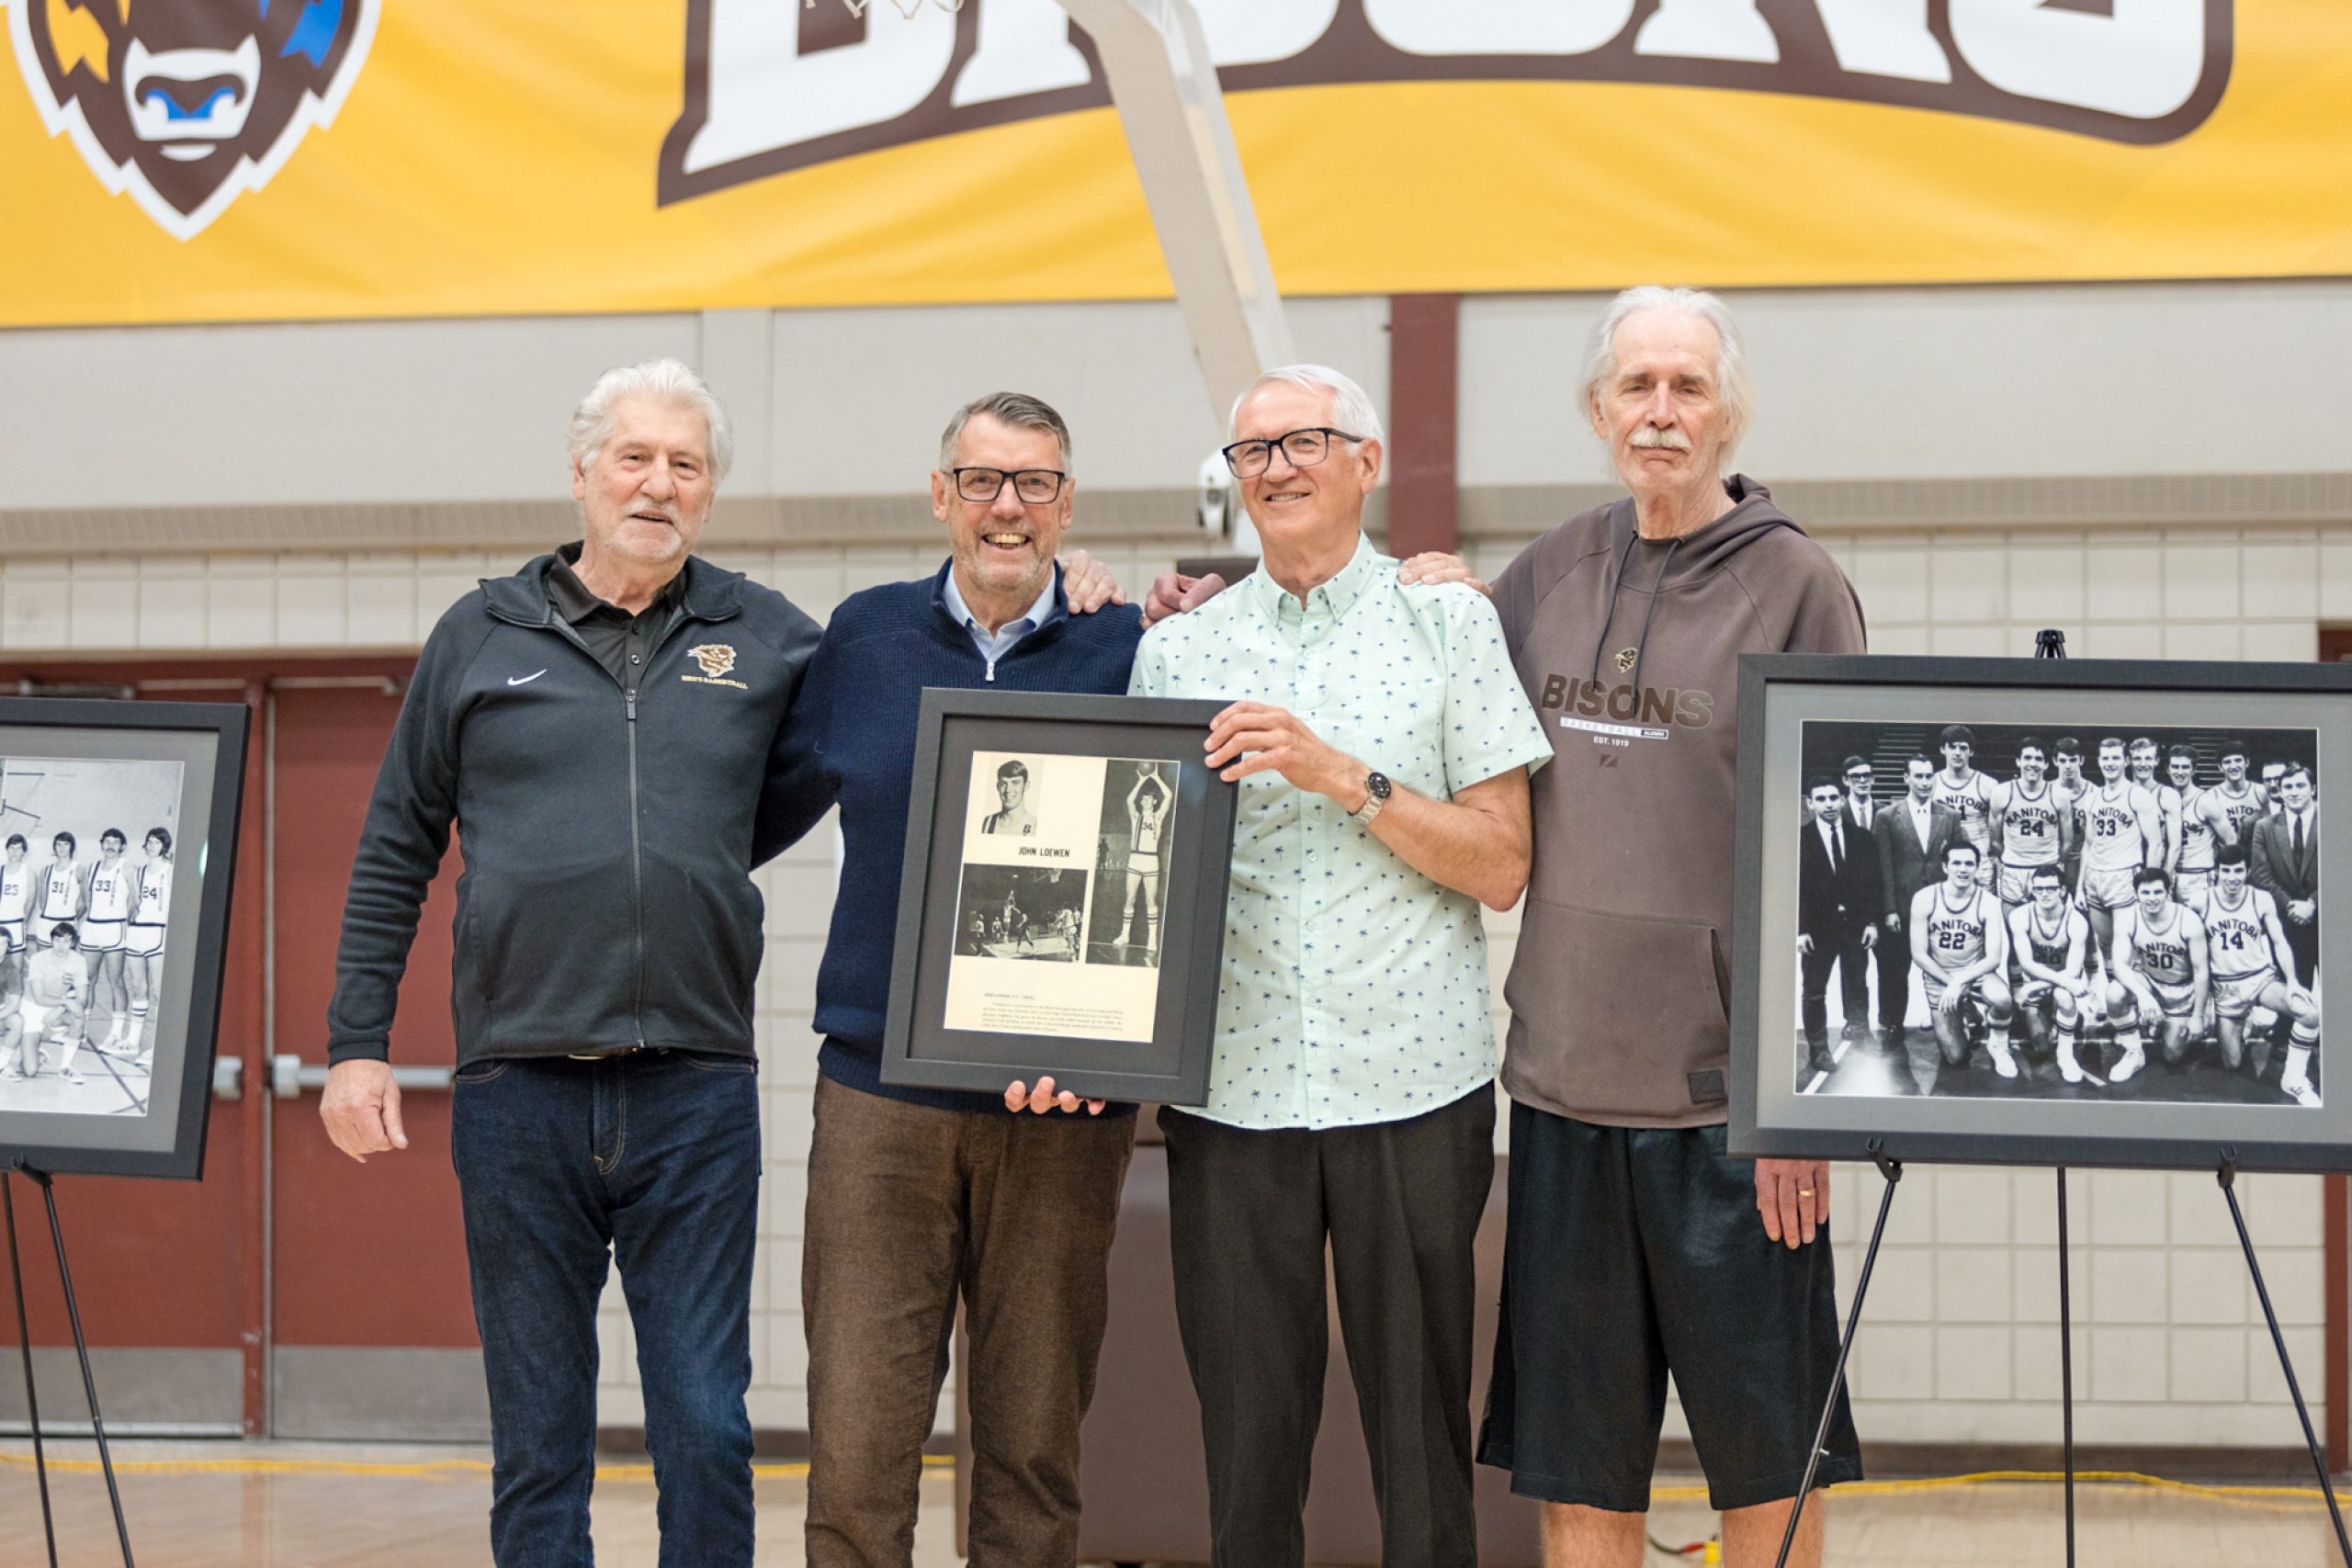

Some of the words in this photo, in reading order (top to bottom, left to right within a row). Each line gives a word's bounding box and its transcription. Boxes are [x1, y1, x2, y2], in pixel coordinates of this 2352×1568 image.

[1541, 673, 1714, 729] BISONS
[1562, 717, 1640, 737] BASKETBALL
[1593, 736, 1610, 746] EST.
[1611, 738, 1629, 748] 1919
[2019, 818, 2044, 838] 24
[2096, 818, 2117, 837] 33
[1018, 846, 1037, 856] JOHN
[1039, 848, 1070, 858] LOEWEN
[51, 880, 64, 894] 31
[95, 879, 111, 892] 33
[141, 886, 158, 900] 24
[1938, 931, 1966, 950] 22
[2220, 931, 2245, 950] 14
[2147, 953, 2174, 969] 30
